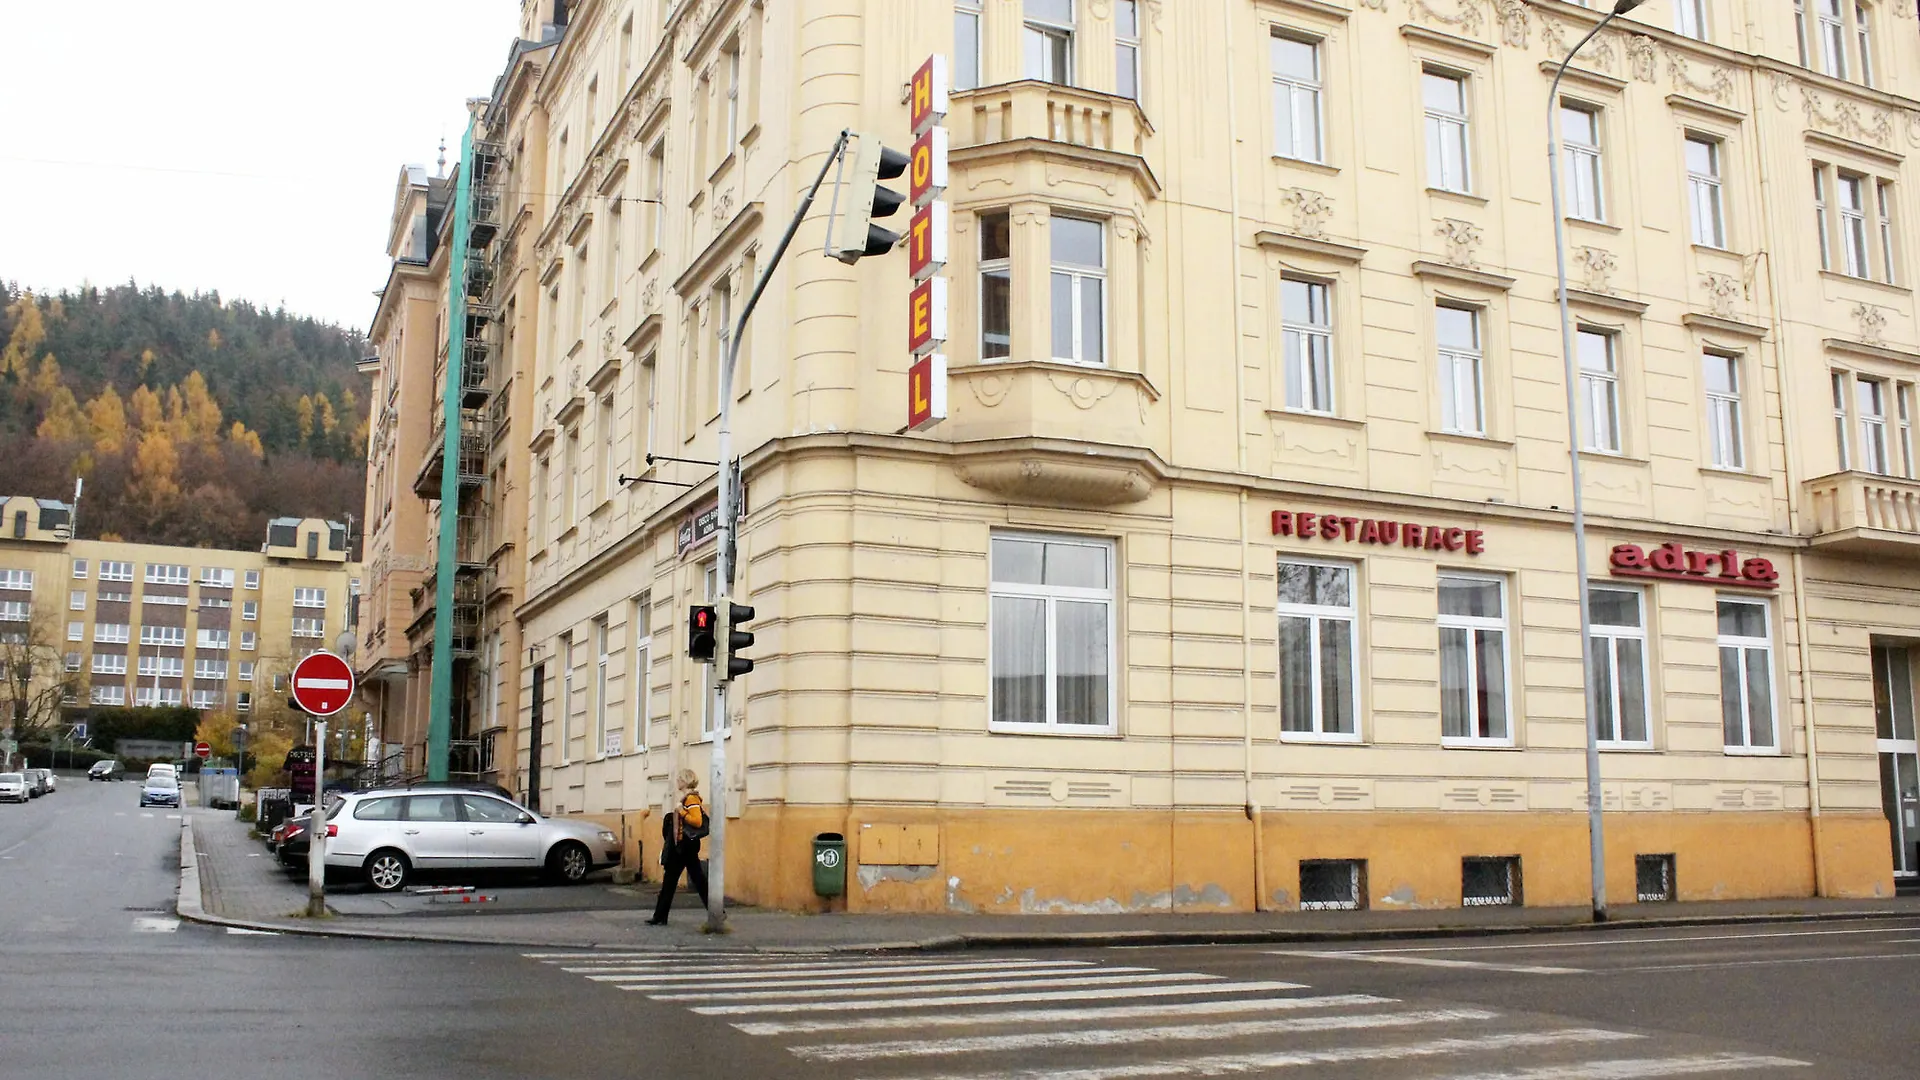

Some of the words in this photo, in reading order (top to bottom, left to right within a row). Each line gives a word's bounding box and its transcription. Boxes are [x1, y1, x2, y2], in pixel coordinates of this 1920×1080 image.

[914, 69, 930, 416] HOTEL
[1271, 509, 1485, 555] RESTAURACE
[1610, 542, 1780, 582] adria
